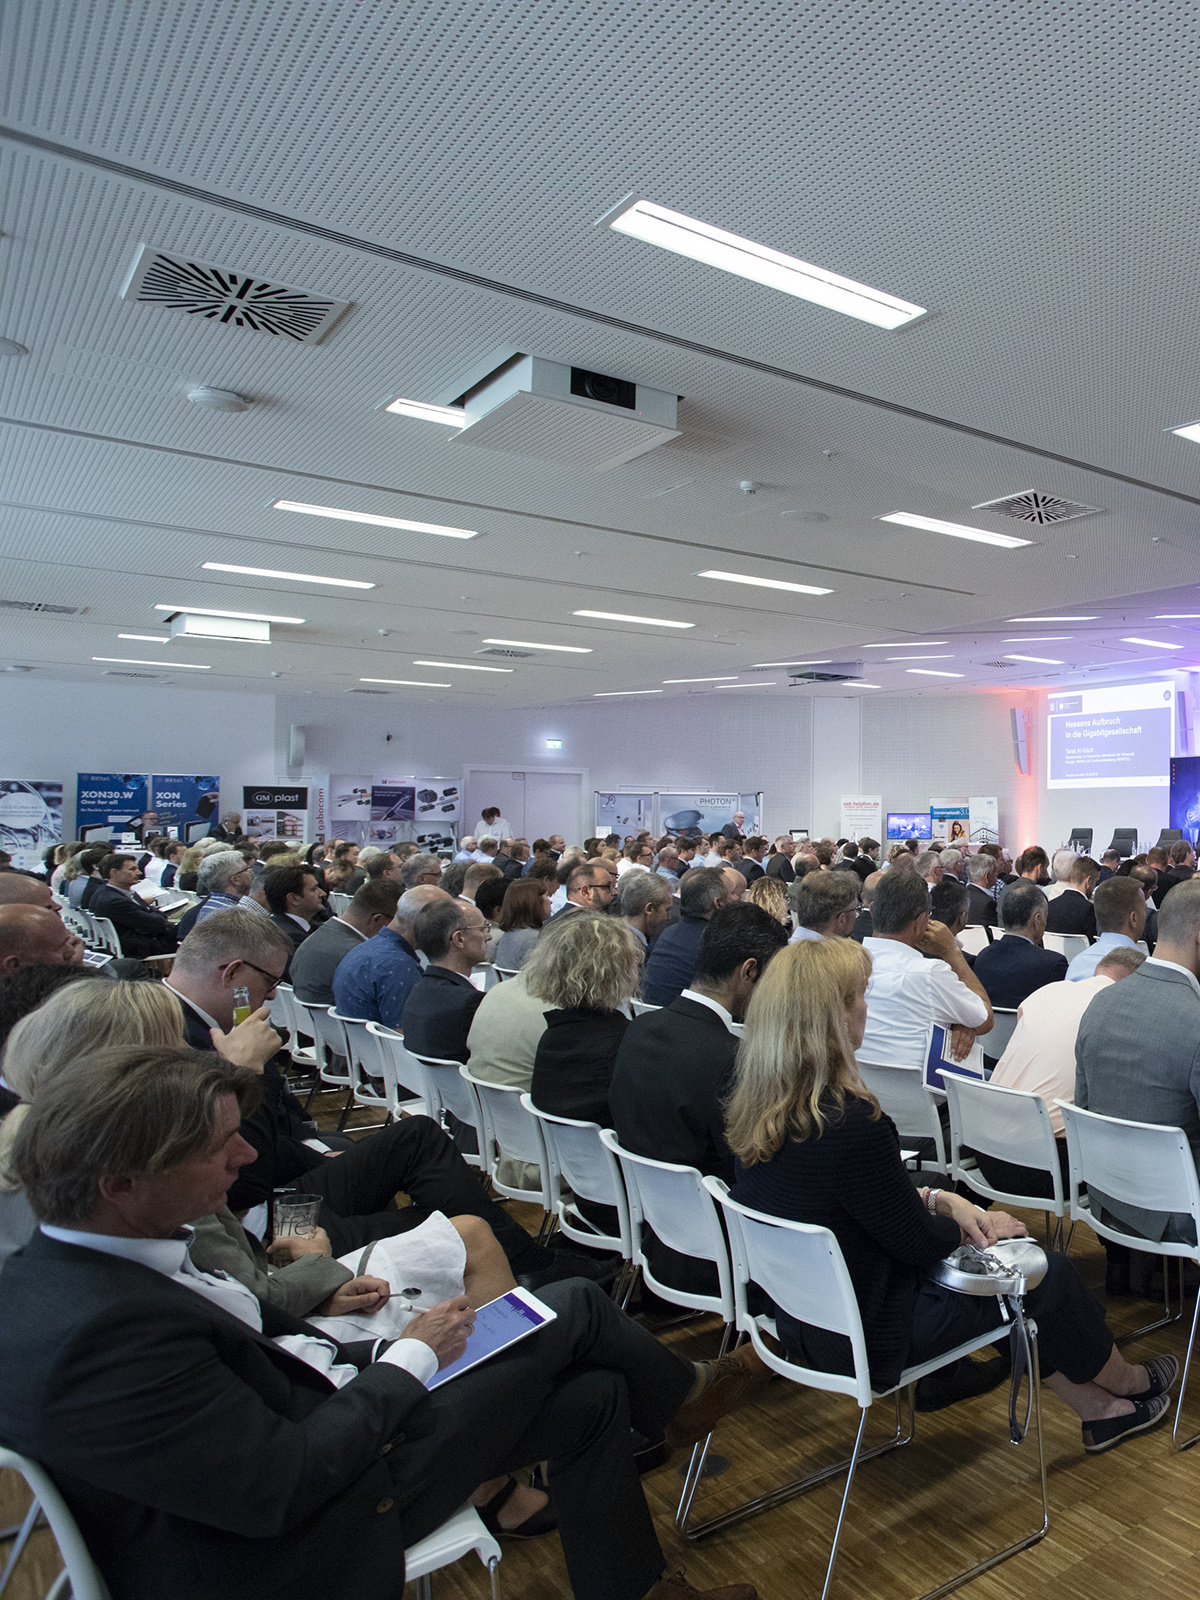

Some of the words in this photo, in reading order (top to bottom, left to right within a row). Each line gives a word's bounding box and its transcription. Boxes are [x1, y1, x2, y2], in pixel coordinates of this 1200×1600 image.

[1065, 719, 1091, 728] Hessens
[1092, 717, 1121, 726] Aufbruch
[1066, 730, 1072, 739] in
[1072, 729, 1082, 738] die
[1083, 726, 1142, 739] Gigabitgesellschaft
[275, 794, 299, 803] plast
[316, 788, 325, 830] gabocom
